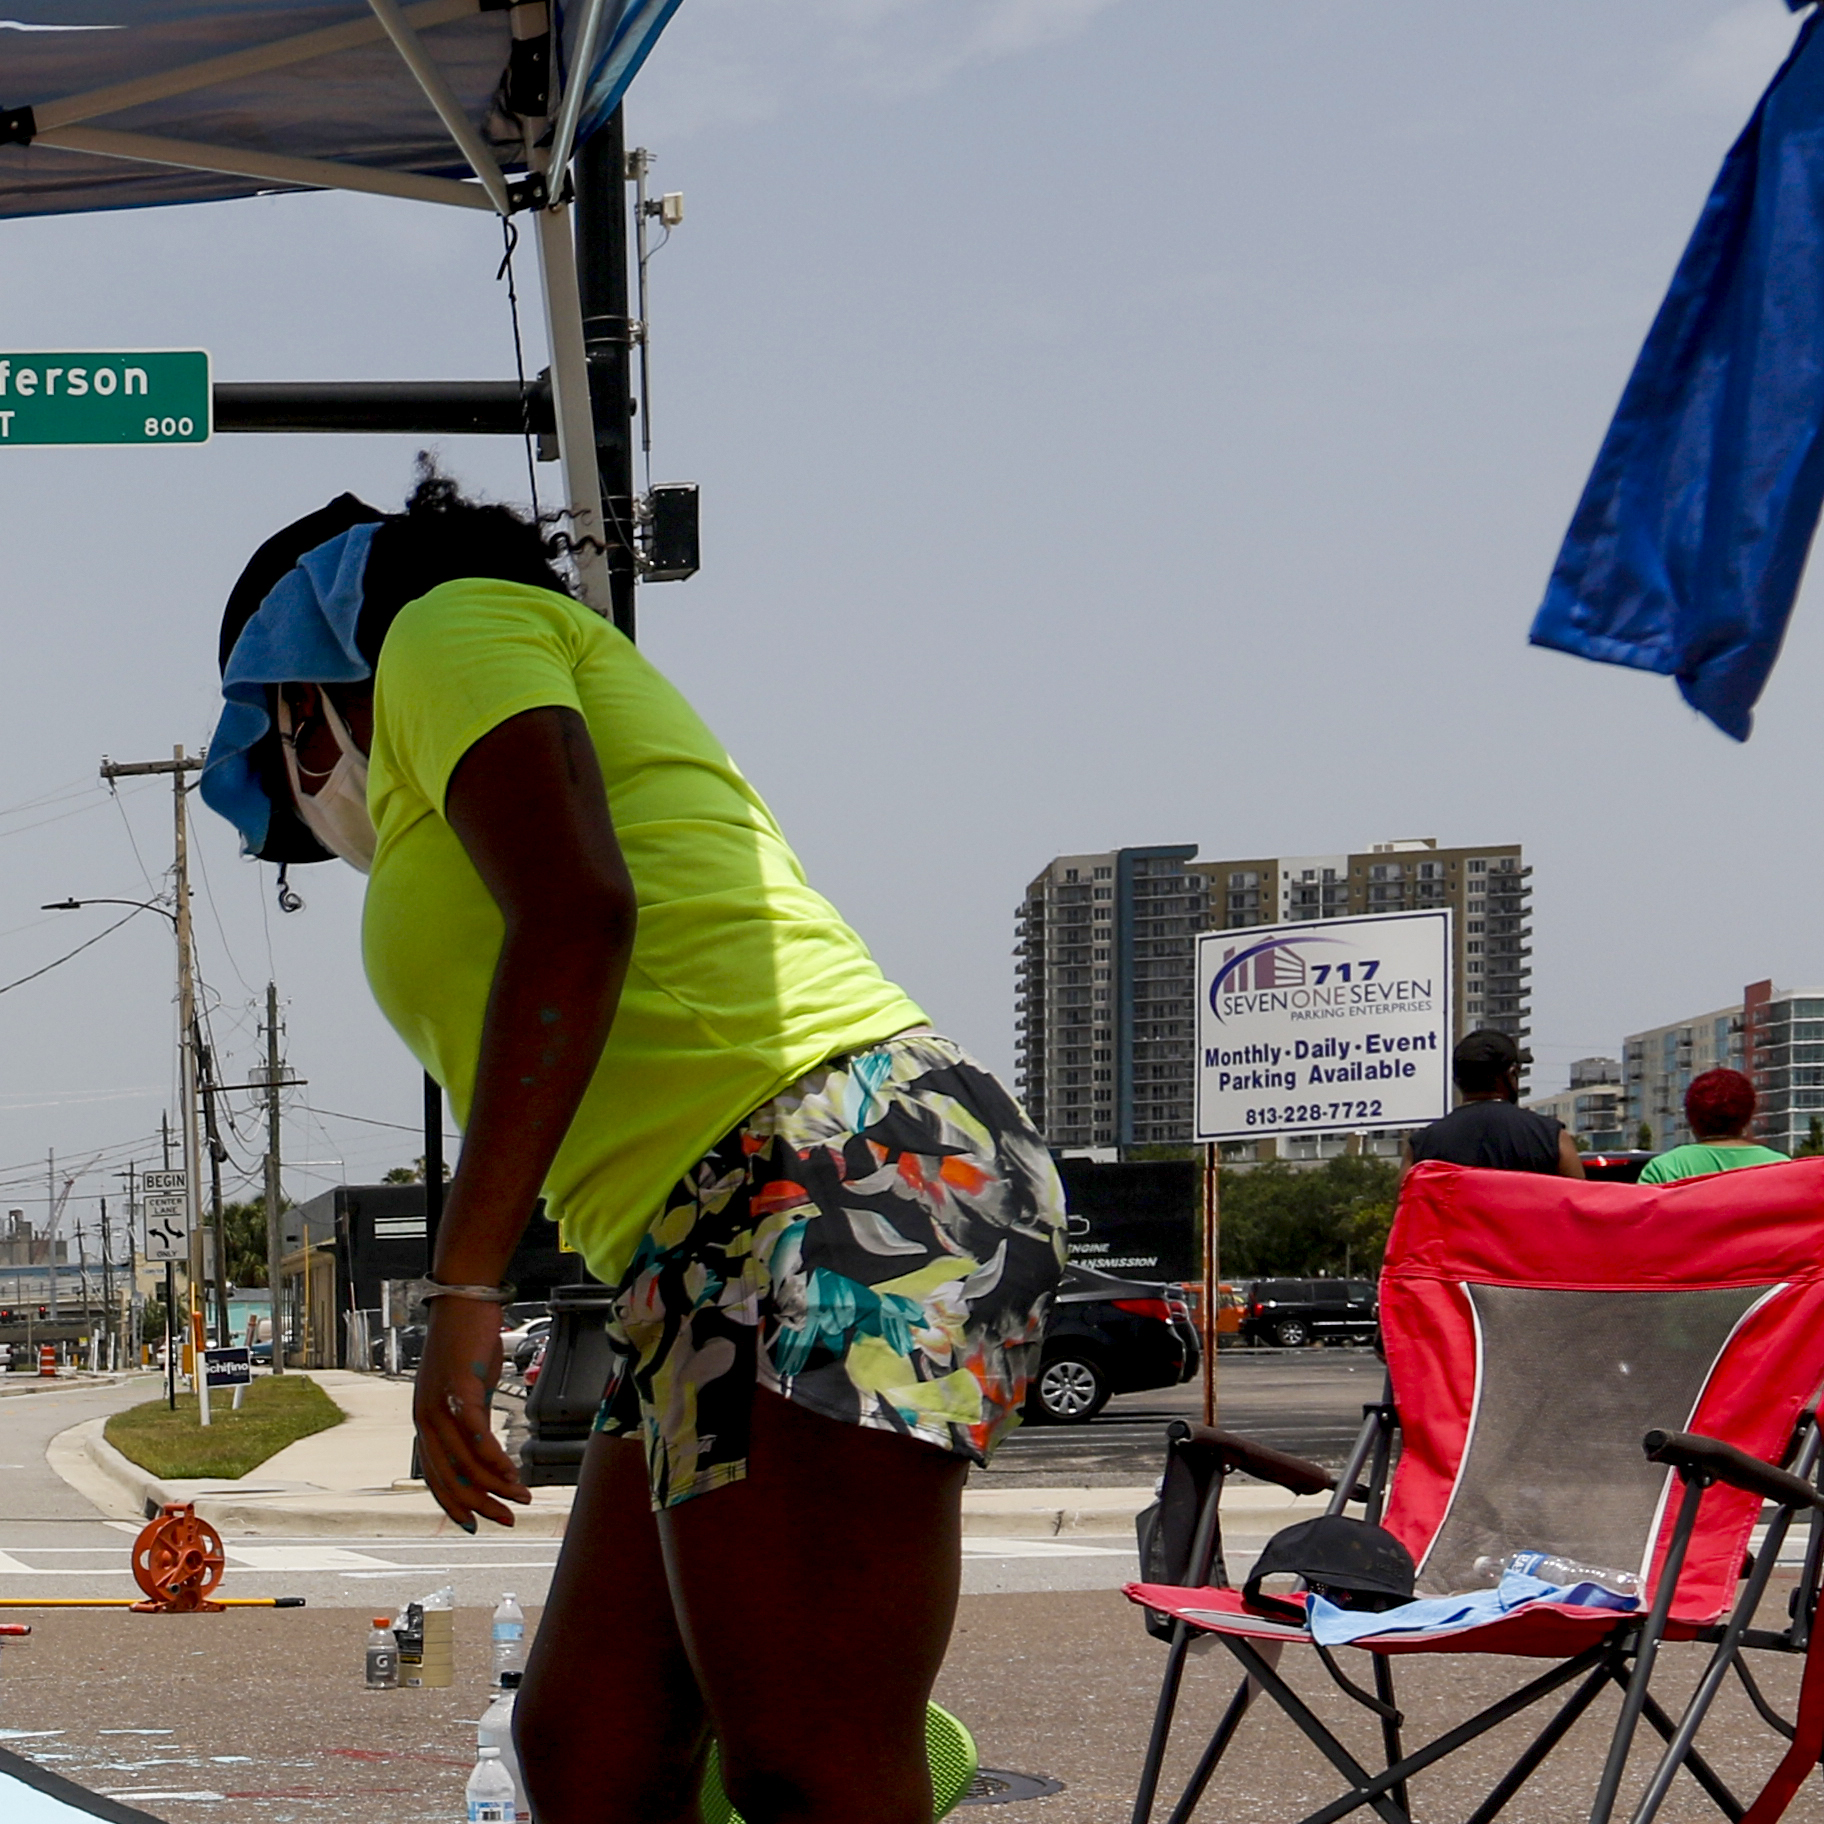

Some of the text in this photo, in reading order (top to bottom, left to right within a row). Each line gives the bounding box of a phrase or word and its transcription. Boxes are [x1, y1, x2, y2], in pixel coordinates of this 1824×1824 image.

[144, 416, 194, 436] 800
[1310, 960, 1380, 986] 717
[1290, 1000, 1432, 1022] PARKING ENTERPRISES
[1205, 1030, 1437, 1068] Monthly Daily Event
[1219, 1058, 1416, 1092] Parking Available
[1246, 1099, 1382, 1126] 813-228-7722
[146, 1174, 185, 1188] BEGIN
[149, 1198, 182, 1206] CENTER
[156, 1250, 177, 1258] ONLY
